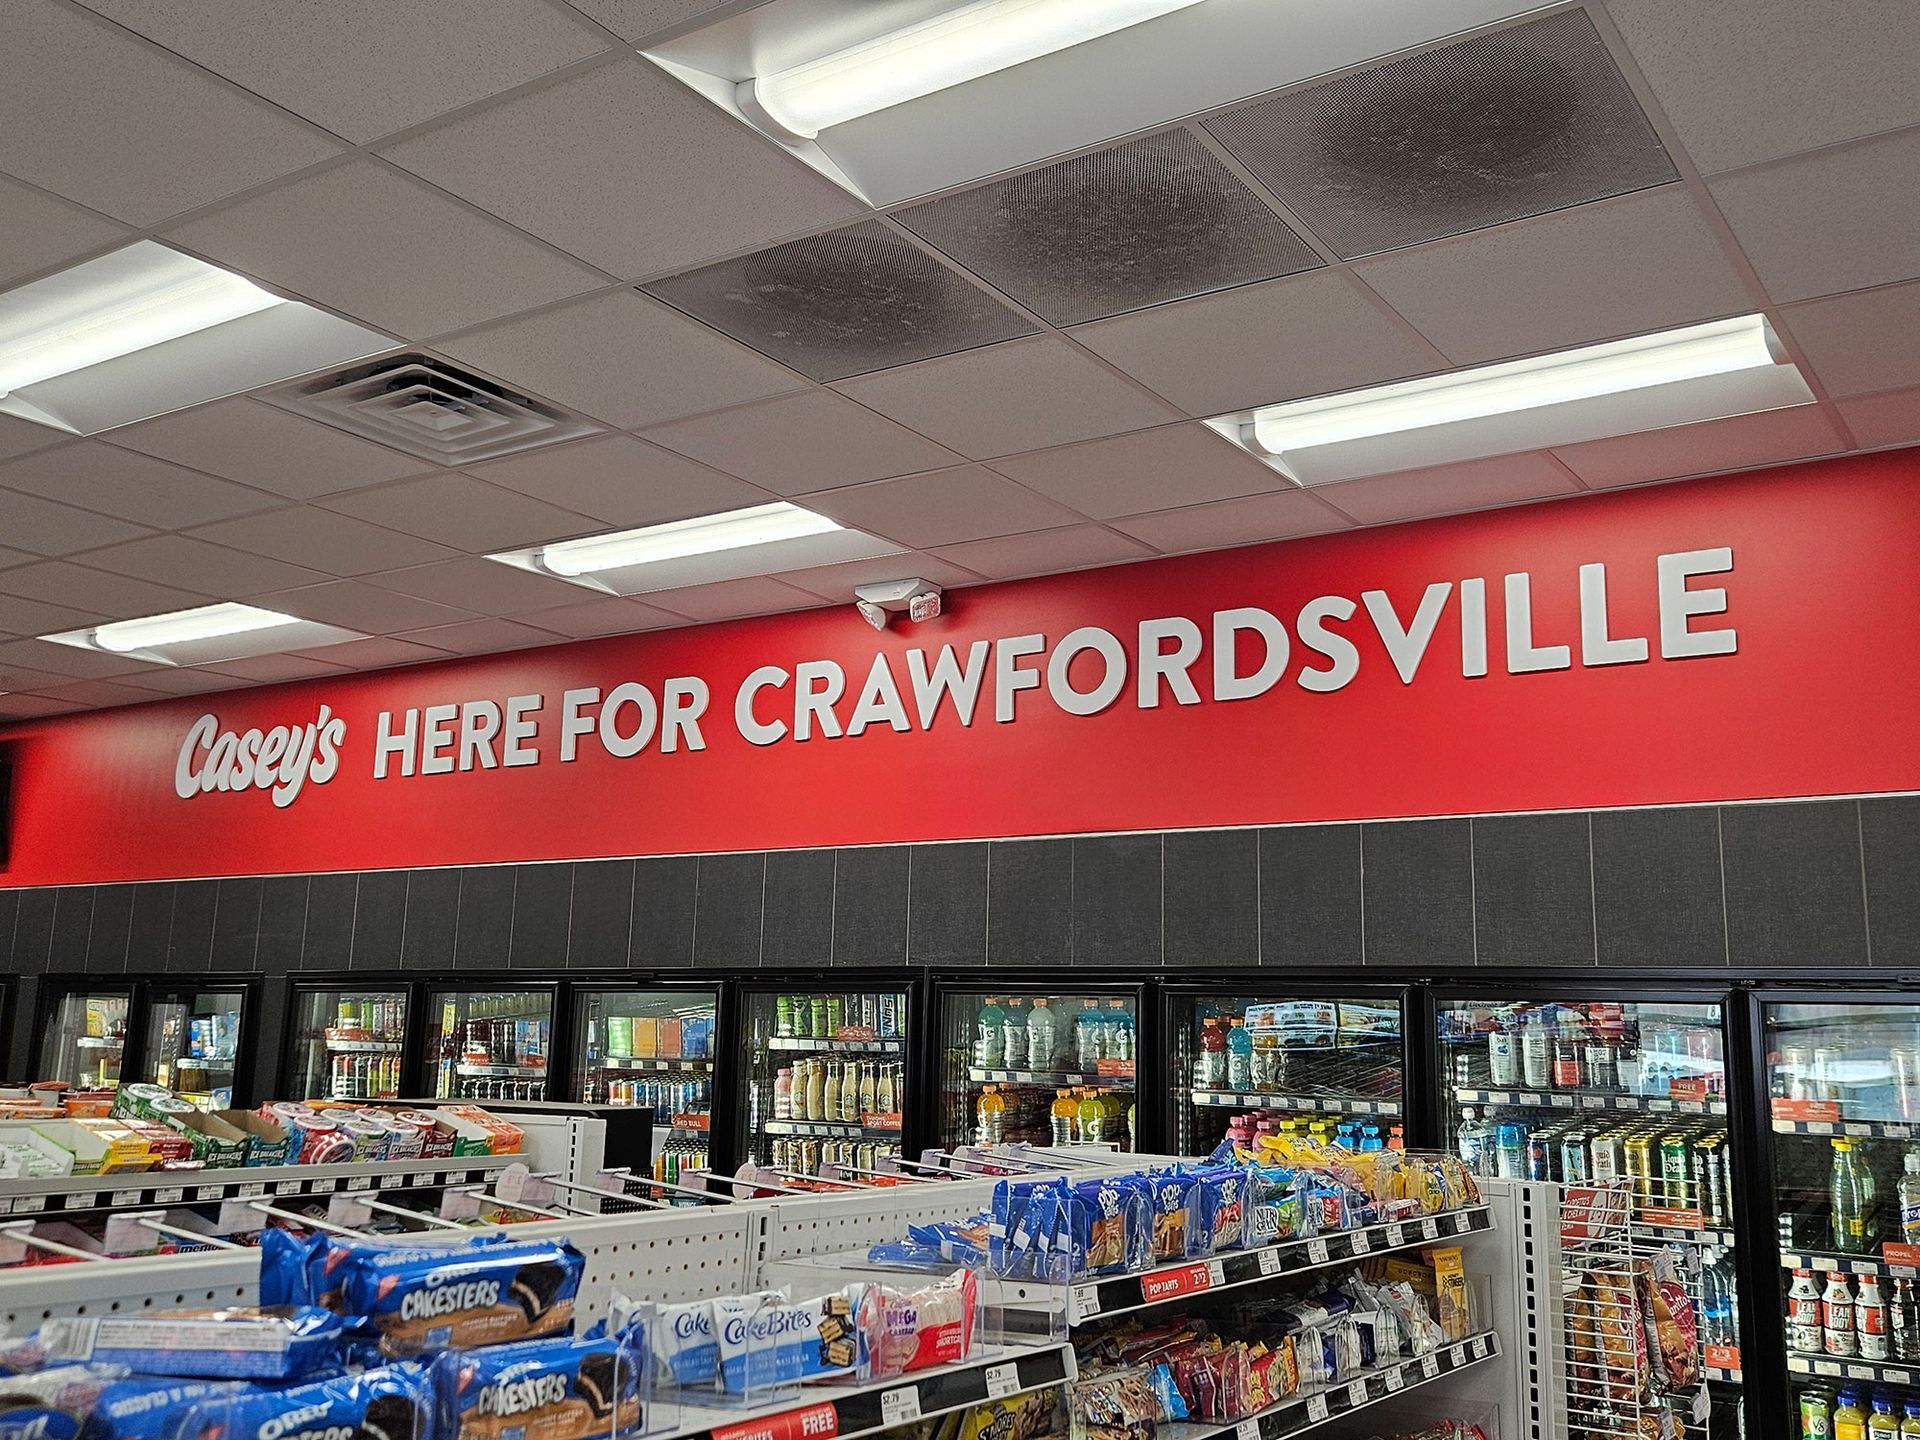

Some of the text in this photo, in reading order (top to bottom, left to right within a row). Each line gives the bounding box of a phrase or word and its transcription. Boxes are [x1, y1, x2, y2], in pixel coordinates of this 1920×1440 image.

[373, 547, 1739, 780] HERE FOR CRAWFORDSVILLE
[175, 704, 347, 808] Casey's
[1885, 1250, 1911, 1258] PROPEL
[401, 1280, 500, 1322] CAKESTERS
[1149, 1279, 1179, 1295] POP TARTS
[725, 1309, 812, 1345] CakeBites
[478, 1373, 568, 1417] CAKESTERS
[801, 1410, 835, 1437] FREE
[1812, 1419, 1825, 1432] V8
